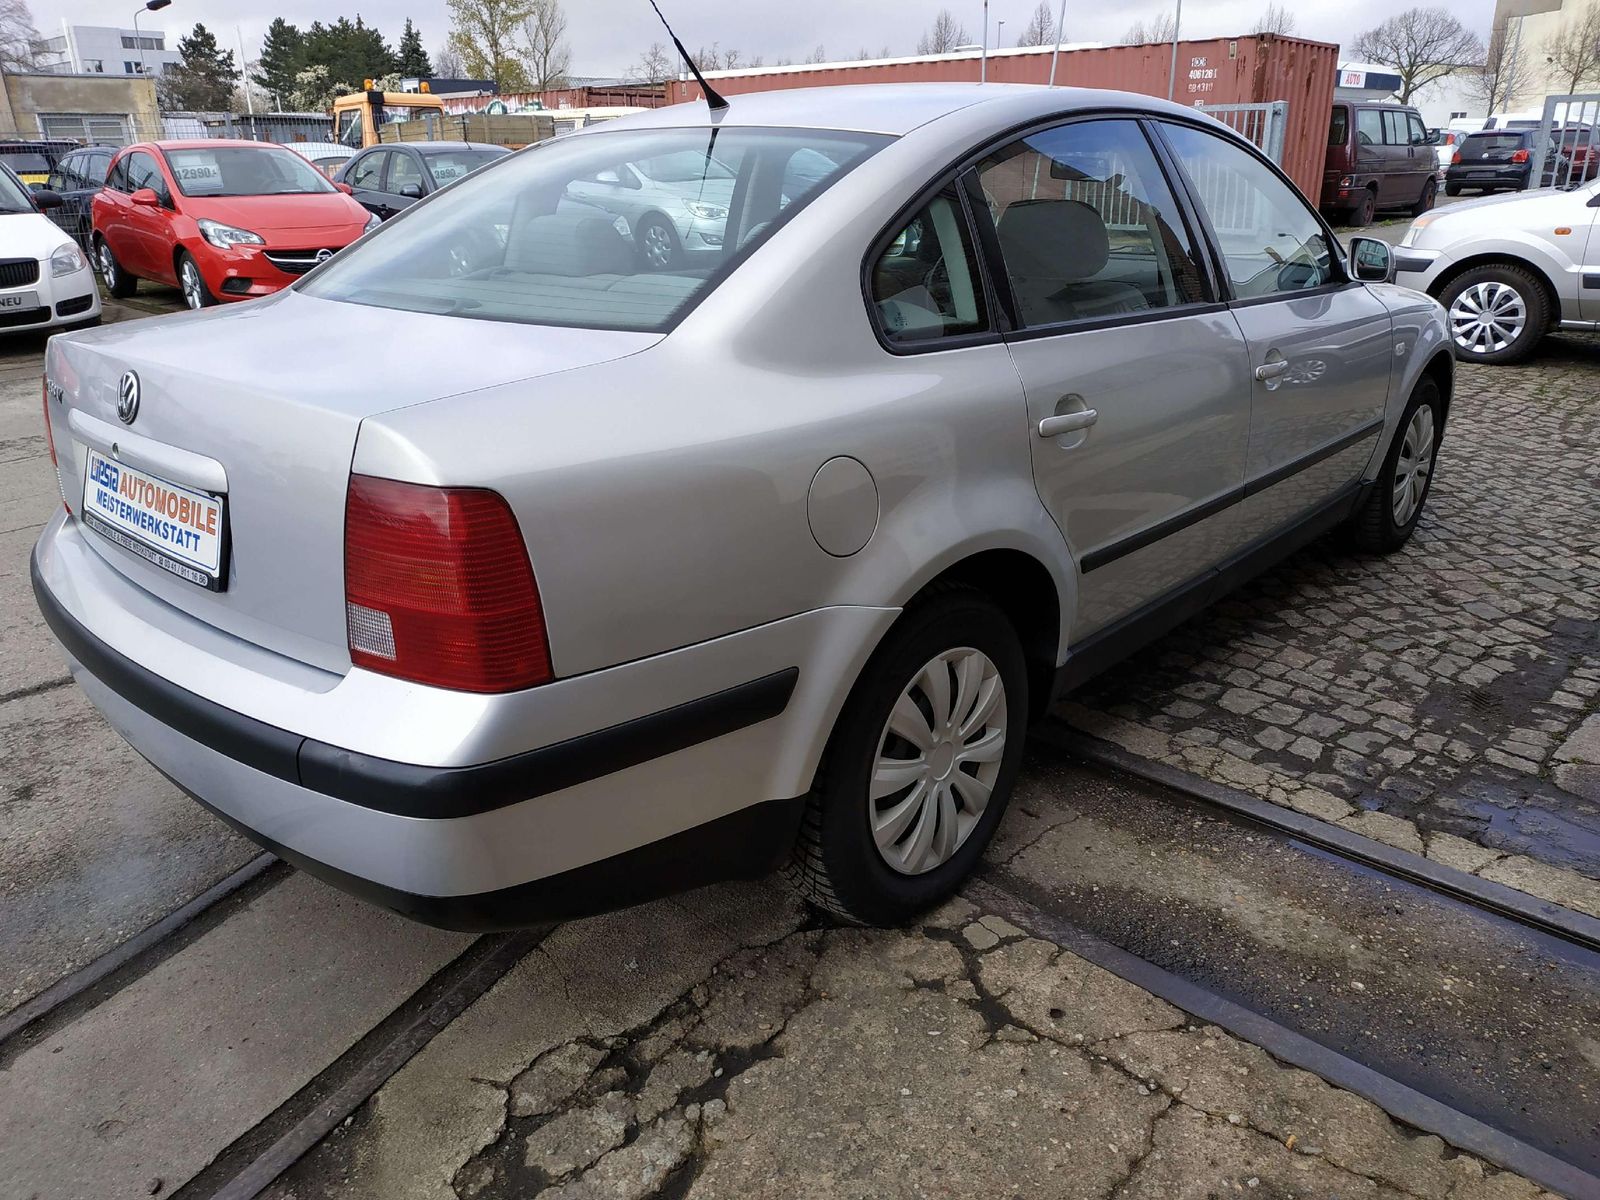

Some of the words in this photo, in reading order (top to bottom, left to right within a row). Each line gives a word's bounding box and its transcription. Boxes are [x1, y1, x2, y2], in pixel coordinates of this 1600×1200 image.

[1344, 73, 1361, 85] AUTO
[0, 297, 22, 307] NEU
[96, 488, 201, 552] MEISTERWERKSTATT
[119, 472, 217, 536] AUTOMOBILE
